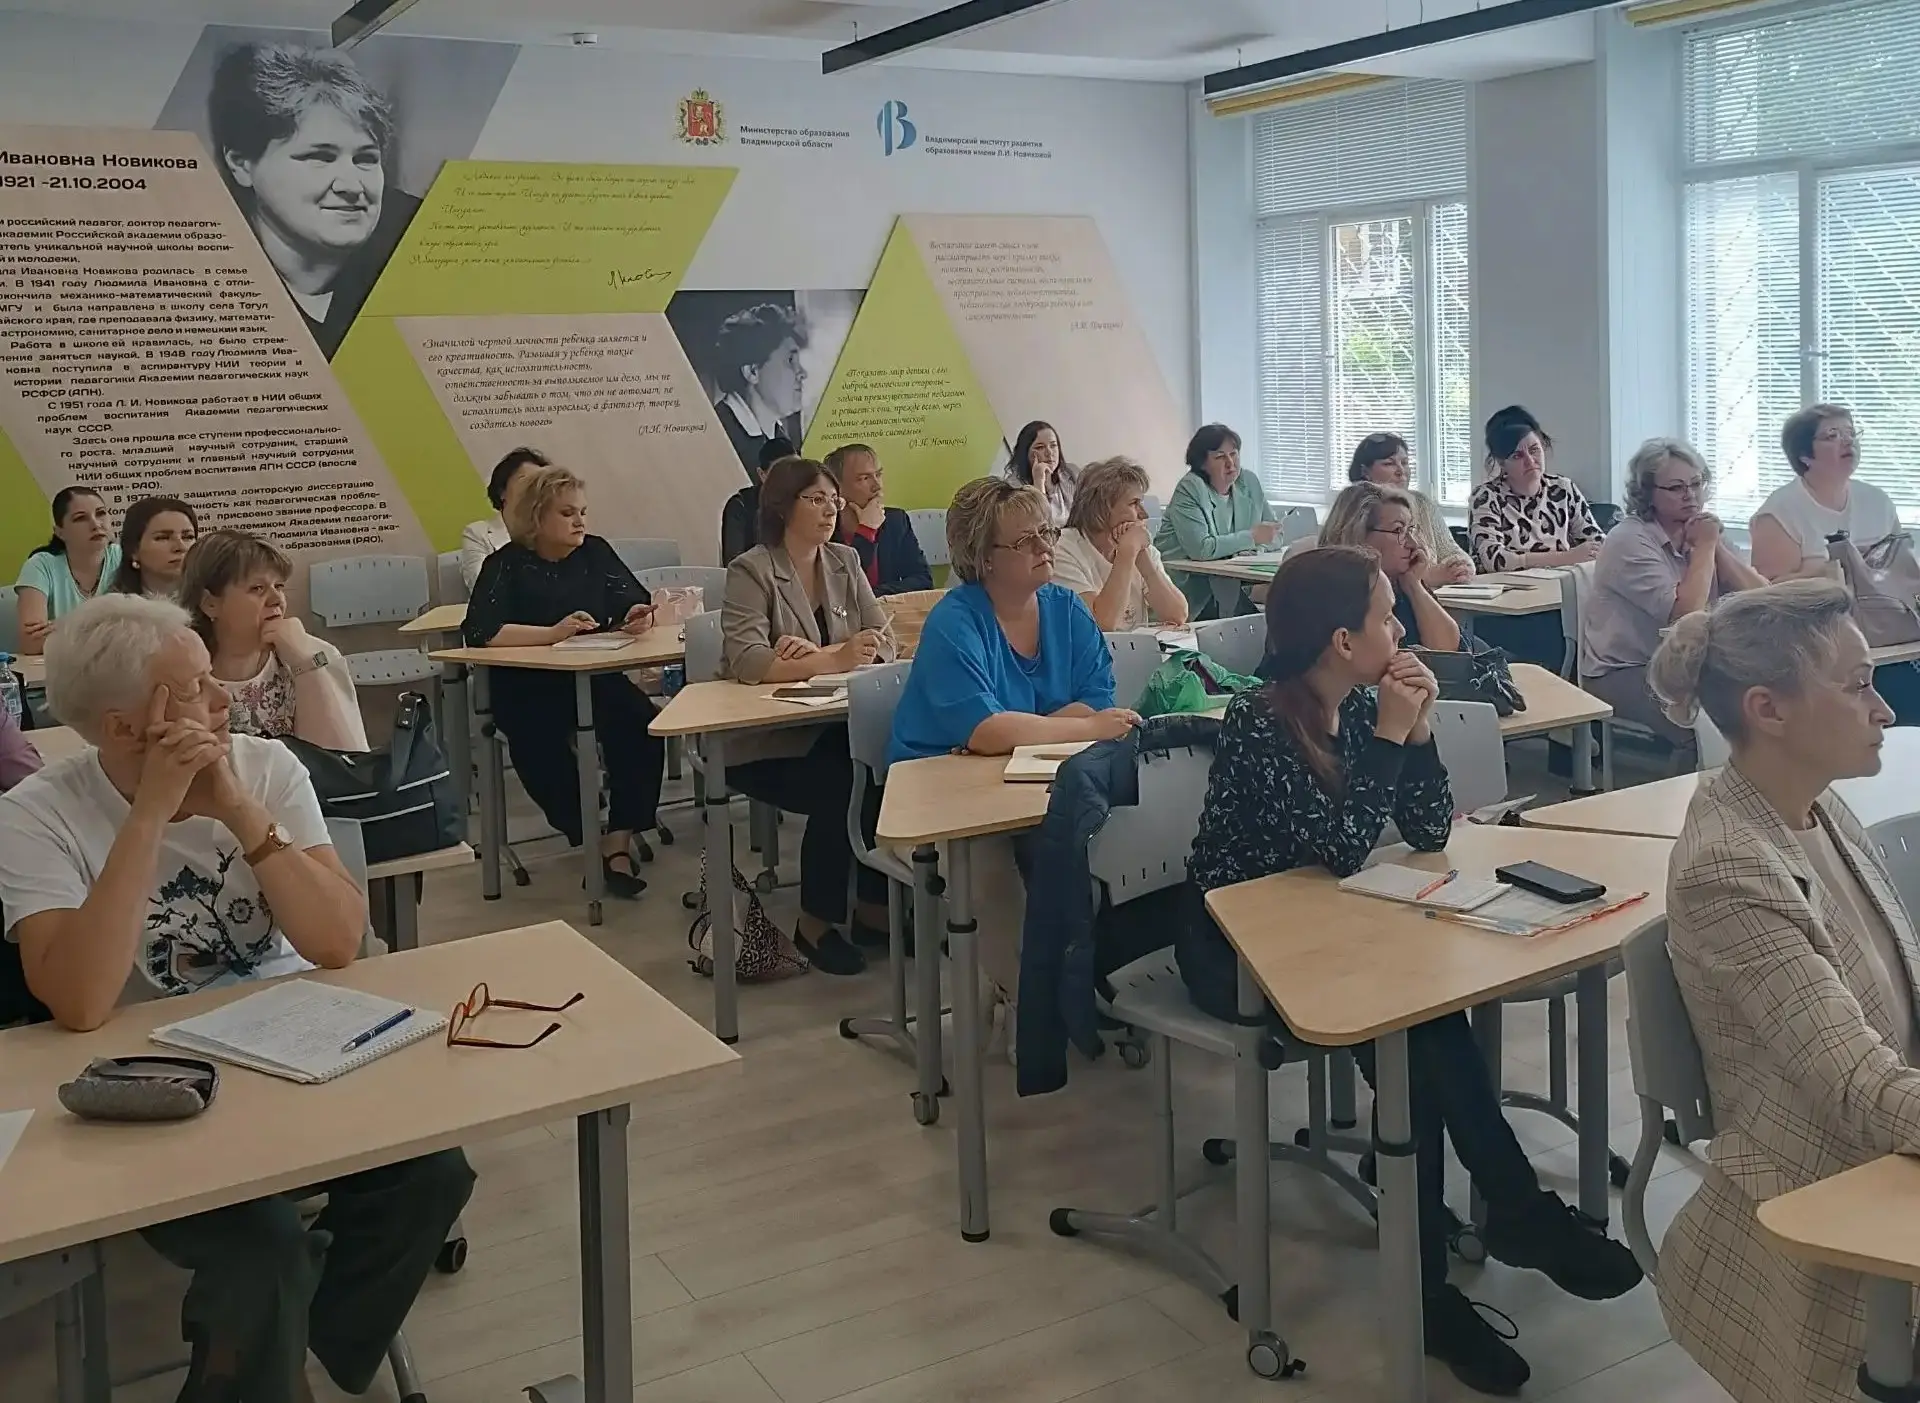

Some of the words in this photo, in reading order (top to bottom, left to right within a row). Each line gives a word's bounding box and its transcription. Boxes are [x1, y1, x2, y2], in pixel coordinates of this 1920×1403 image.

[102, 153, 197, 169] Новикова
[41, 176, 147, 190] -21.10.2004
[6, 217, 76, 227] российский
[126, 220, 165, 228] доктор
[55, 229, 124, 238] Российской
[126, 231, 181, 239] академии
[34, 242, 102, 252] уникальной
[106, 242, 153, 252] научной
[20, 266, 78, 275] Ивановна
[83, 266, 138, 275] Новикова
[142, 268, 194, 276] родилась
[30, 279, 55, 287] 1941
[93, 278, 147, 287] Людмила
[153, 278, 207, 286] Ивановна
[52, 303, 83, 312] была
[87, 303, 154, 312] направлена
[170, 303, 204, 311] школу
[238, 300, 268, 310] Тогул
[98, 315, 172, 324] преподавала
[78, 327, 145, 337] санитарное
[10, 340, 52, 349] Работа
[72, 340, 109, 348] школе
[218, 336, 246, 344] было
[39, 353, 91, 361] заняться
[159, 349, 185, 358] 1948
[217, 347, 267, 356] Людмила
[5, 366, 40, 374] новна
[51, 364, 112, 374] поступила
[140, 362, 210, 371] аспирантуру
[214, 359, 239, 368] НИИ
[249, 359, 286, 368] теории
[13, 378, 62, 387] истории
[70, 375, 135, 385] педагогики
[138, 373, 194, 382] Академии
[197, 371, 282, 380] педагогических
[21, 388, 66, 398] РСФСР
[59, 400, 83, 409] 1951
[144, 396, 198, 406] Новикова
[201, 394, 249, 405] работает
[261, 392, 285, 401] НИИ
[288, 391, 321, 401] общих
[37, 412, 87, 423] проблем
[103, 410, 169, 420] воспитания
[185, 406, 239, 416] Академии
[246, 404, 328, 414] педагогических
[45, 426, 72, 436] наук
[72, 435, 107, 445] Здесь
[132, 433, 175, 444] прошла
[198, 430, 242, 441] ступени
[122, 444, 174, 455] младший
[188, 441, 235, 453] научный
[304, 435, 348, 446] старший
[124, 457, 181, 468] сотрудник
[200, 452, 245, 462] главный
[302, 448, 354, 458] сотрудник
[75, 471, 102, 481] НИИ
[144, 467, 192, 478] проблем
[194, 464, 256, 475] воспитания
[259, 461, 283, 471] АПН
[285, 460, 316, 469] СССР
[183, 489, 236, 499] защитила
[241, 485, 303, 496] докторскую
[307, 480, 374, 491] диссертацию
[255, 494, 336, 506] педагогическая
[216, 509, 273, 521] присвоено
[275, 507, 312, 516] звание
[289, 515, 341, 526] Академии
[270, 529, 318, 540] Людмила
[320, 524, 369, 535] Ивановна
[285, 537, 351, 550] образования
